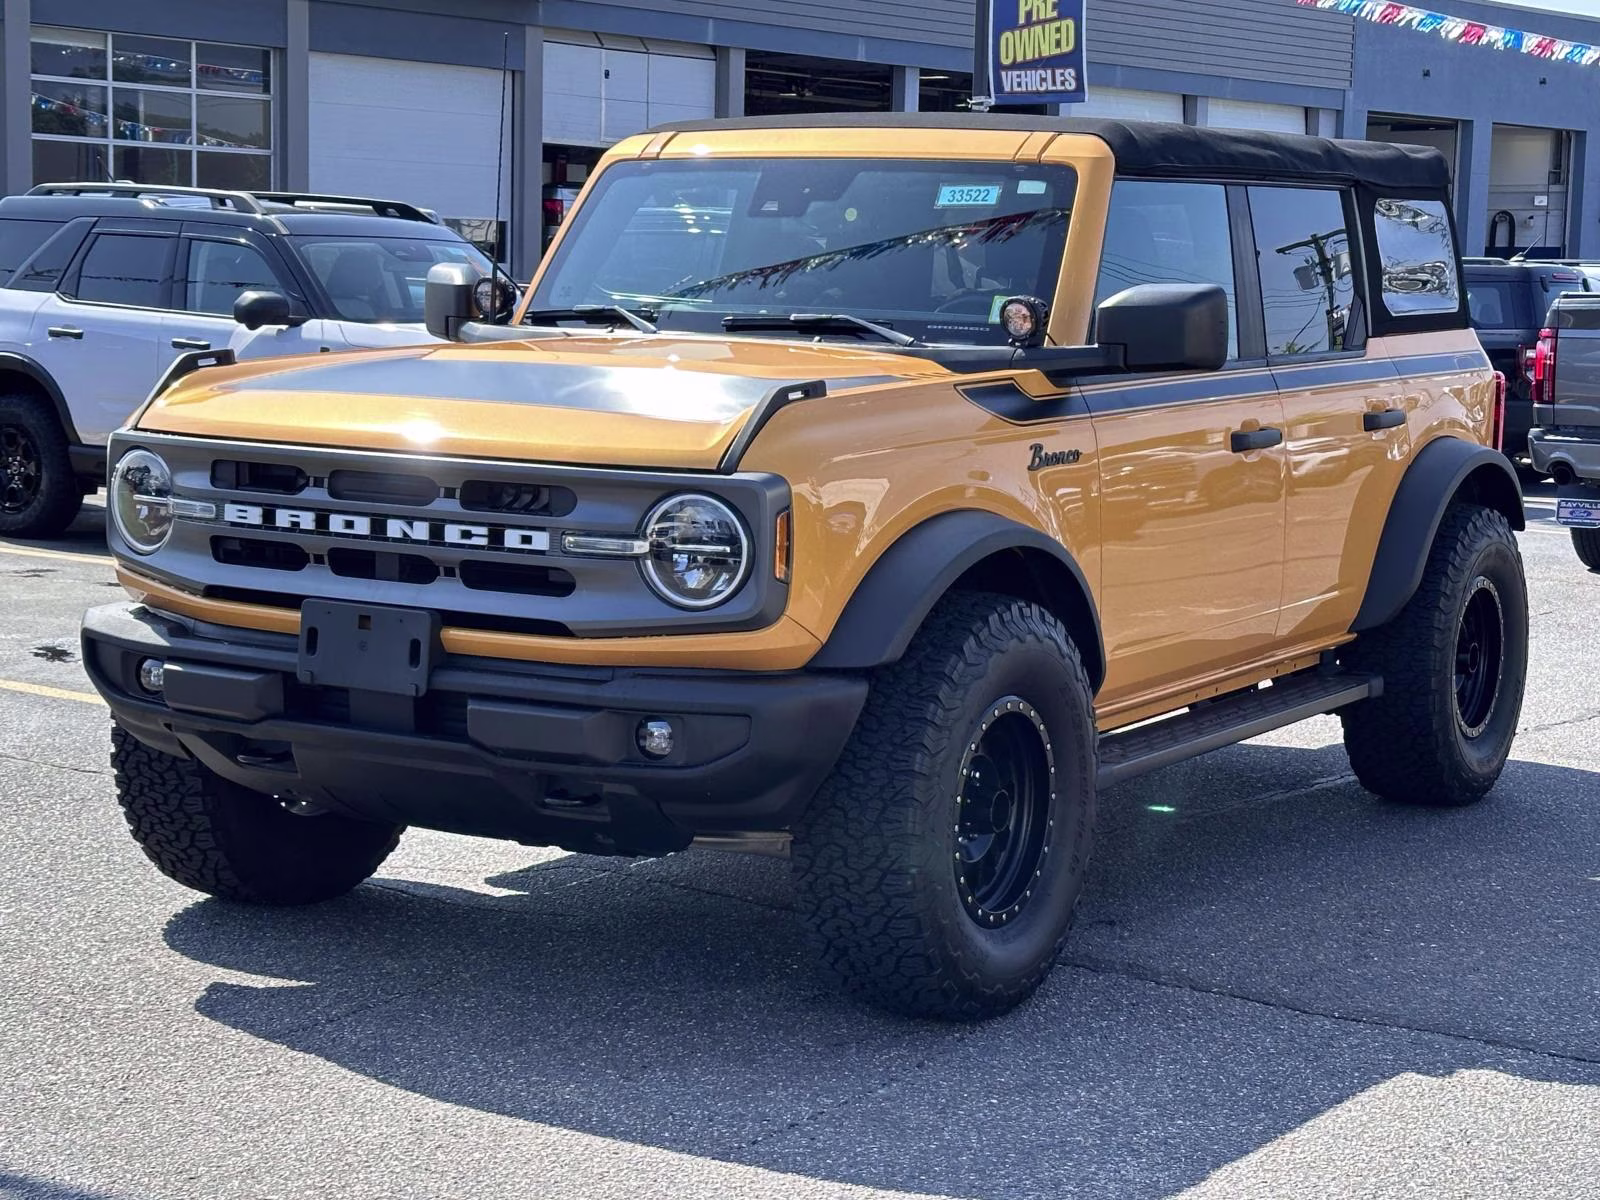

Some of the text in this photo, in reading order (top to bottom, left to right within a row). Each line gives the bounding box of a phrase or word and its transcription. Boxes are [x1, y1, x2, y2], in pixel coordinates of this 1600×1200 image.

[1018, 0, 1058, 25] PRE
[1000, 18, 1075, 65] OWNED
[1001, 68, 1077, 92] VEHICLES
[947, 188, 990, 203] 33522
[1027, 443, 1082, 471] Bronco
[223, 502, 550, 551] BRONCO
